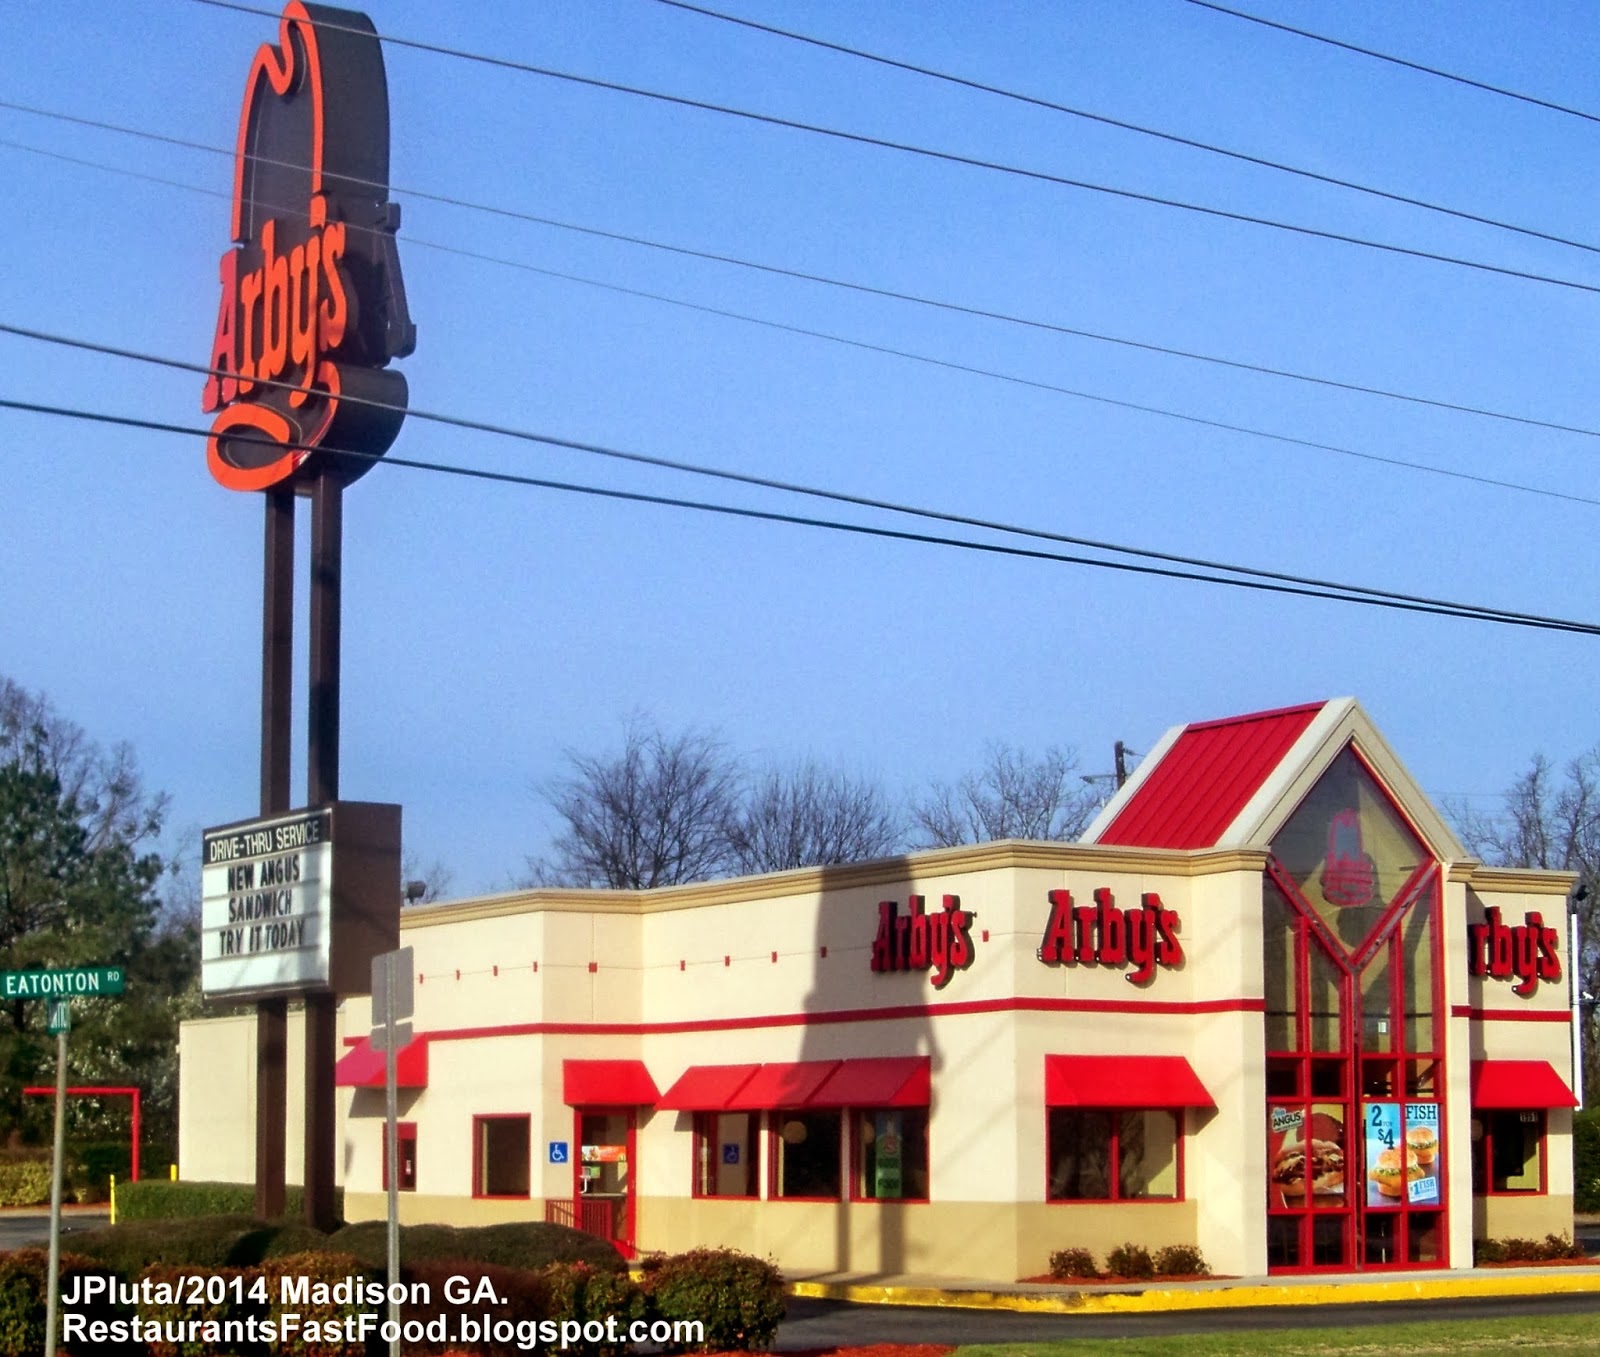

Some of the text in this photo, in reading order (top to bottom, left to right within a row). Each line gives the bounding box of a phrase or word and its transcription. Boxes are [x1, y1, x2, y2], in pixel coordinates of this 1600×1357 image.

[202, 196, 347, 413] Arby's
[210, 820, 319, 862] DRIVE-THRU SERVICE
[228, 855, 300, 892] NEW ANGUS
[229, 890, 292, 922] SANDWICH
[219, 919, 305, 956] TRY IT TODAY
[871, 894, 968, 986] Arby's
[1037, 887, 1182, 983] Arby's
[1468, 906, 1562, 994] rby's
[6, 971, 119, 994] EATONTON RD
[1273, 1111, 1301, 1127] ANGUS
[1371, 1104, 1382, 1126] 2
[1405, 1105, 1437, 1120] FISH
[1377, 1128, 1394, 1149] $4
